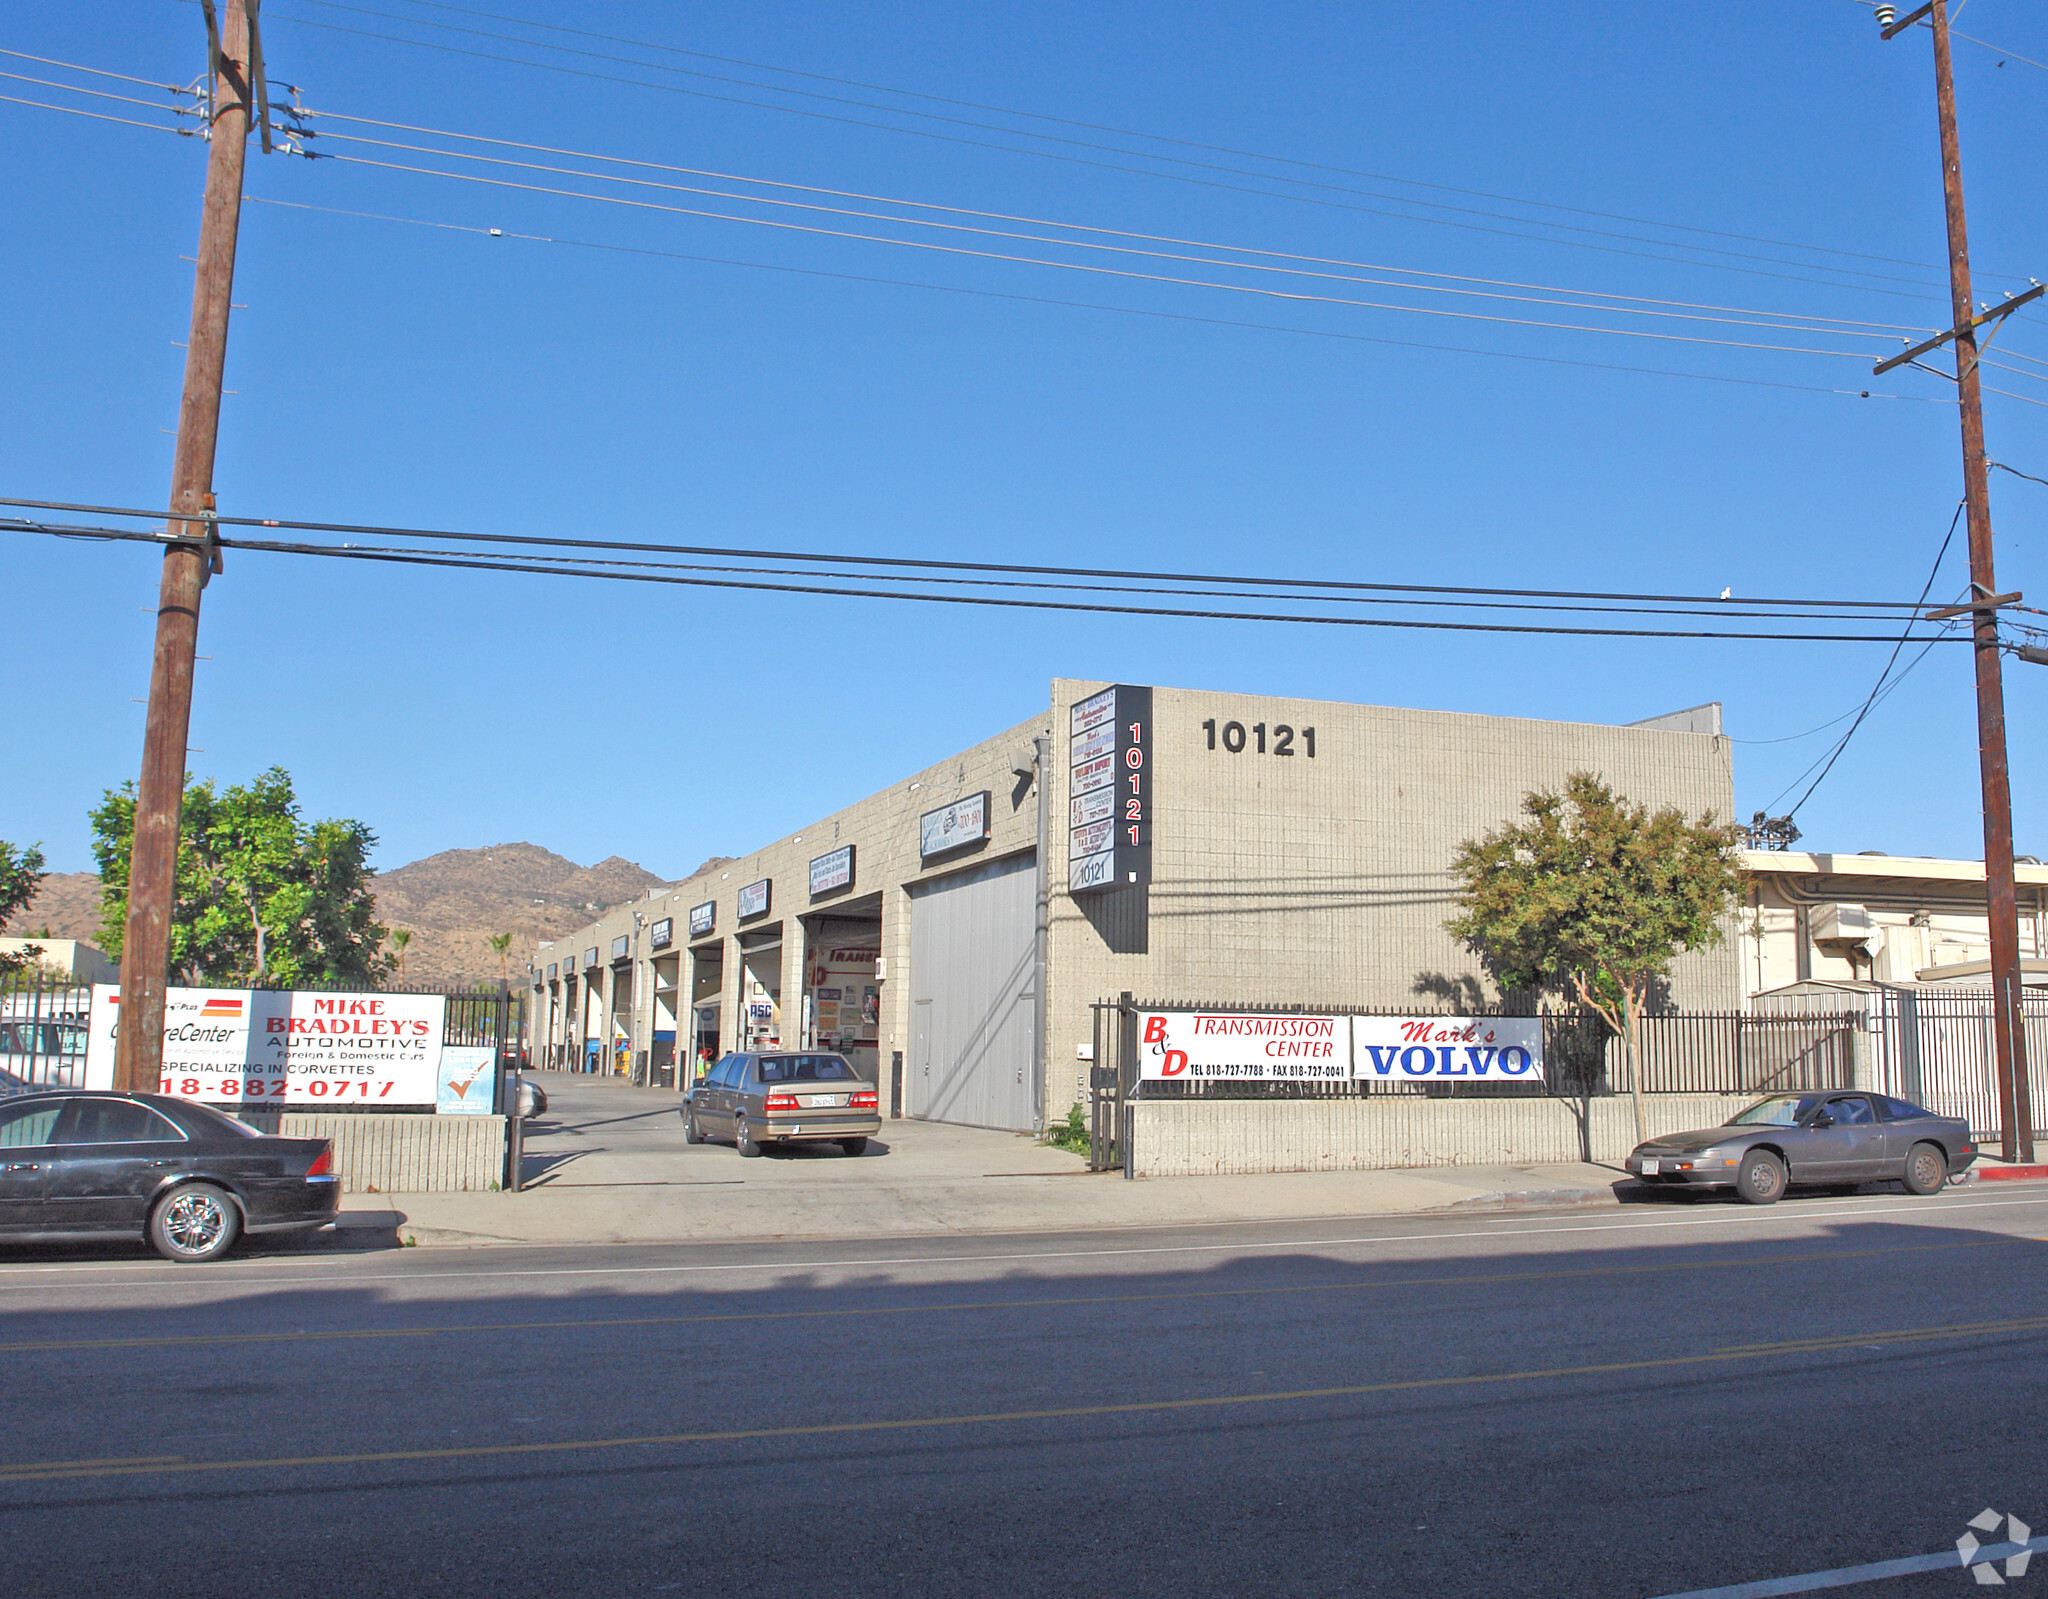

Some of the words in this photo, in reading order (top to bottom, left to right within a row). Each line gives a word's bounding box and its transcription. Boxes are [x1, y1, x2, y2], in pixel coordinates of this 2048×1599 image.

[1202, 718, 1316, 758] 10121
[1126, 723, 1143, 846] 10121
[1080, 861, 1105, 883] 10121
[314, 999, 385, 1015] MIKE
[750, 1004, 772, 1018] ASC
[266, 1017, 430, 1036] BRADLEY'S
[1143, 1016, 1168, 1043] B
[1193, 1016, 1334, 1037] TRANSMISSION
[1400, 1021, 1497, 1043] Mark's
[267, 1037, 427, 1049] AUTOMOTIVE
[1152, 1033, 1171, 1056] &
[1265, 1041, 1333, 1058] CENTER
[277, 1051, 323, 1060] Foreign
[328, 1052, 335, 1060] &
[340, 1052, 395, 1060] Domestic
[1161, 1049, 1188, 1077] D
[1365, 1045, 1532, 1076] VOLVO
[161, 1062, 263, 1074] SPECIALIZING
[268, 1064, 282, 1074] IN
[287, 1064, 375, 1075] CORVETTES
[1190, 1064, 1204, 1076] TEL
[1206, 1064, 1264, 1076] 818-727-7788
[1272, 1066, 1288, 1077] FAX
[1289, 1066, 1344, 1078] 818-727-0041
